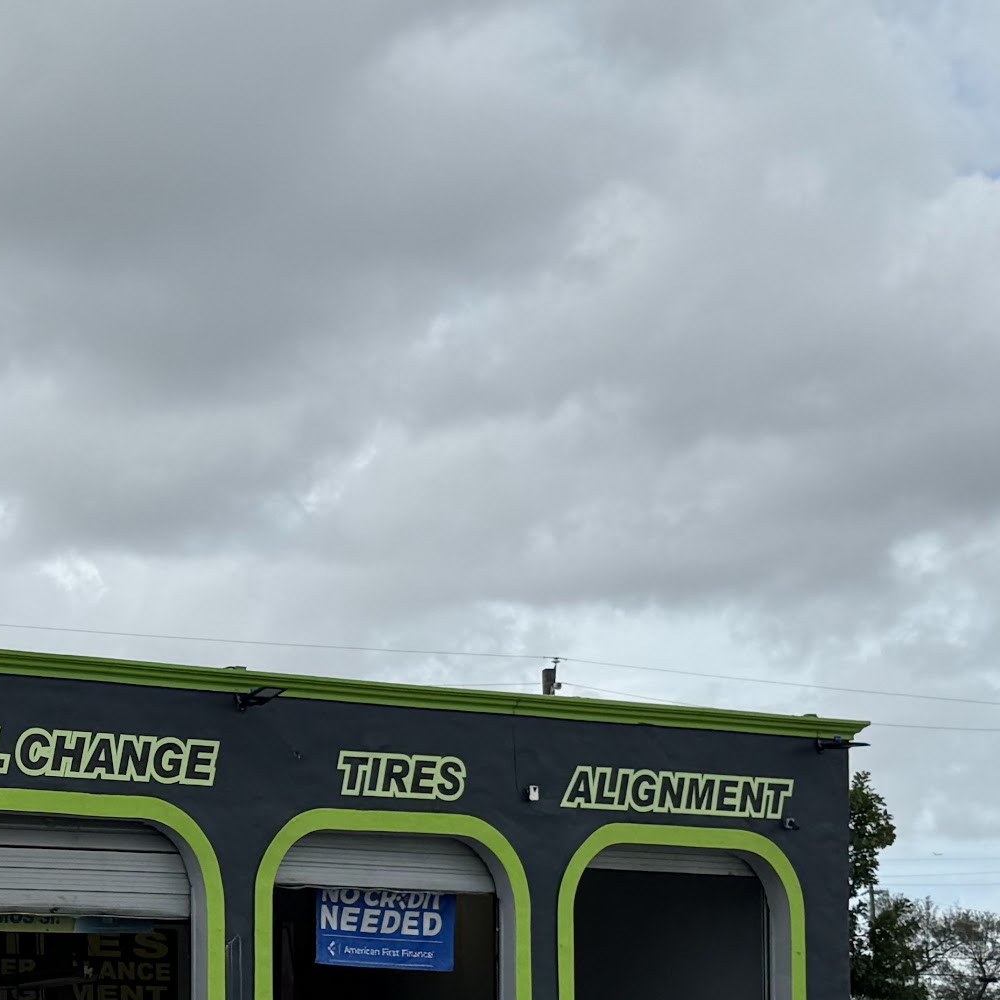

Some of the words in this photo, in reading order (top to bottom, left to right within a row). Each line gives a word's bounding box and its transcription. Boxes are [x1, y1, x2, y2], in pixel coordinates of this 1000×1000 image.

[15, 727, 220, 786] CHANGE
[337, 750, 466, 801] TIRES
[560, 765, 794, 819] ALIGNMENT
[320, 904, 442, 936] NEEDED
[344, 946, 381, 956] American
[382, 948, 399, 957] First
[402, 949, 434, 959] Finance
